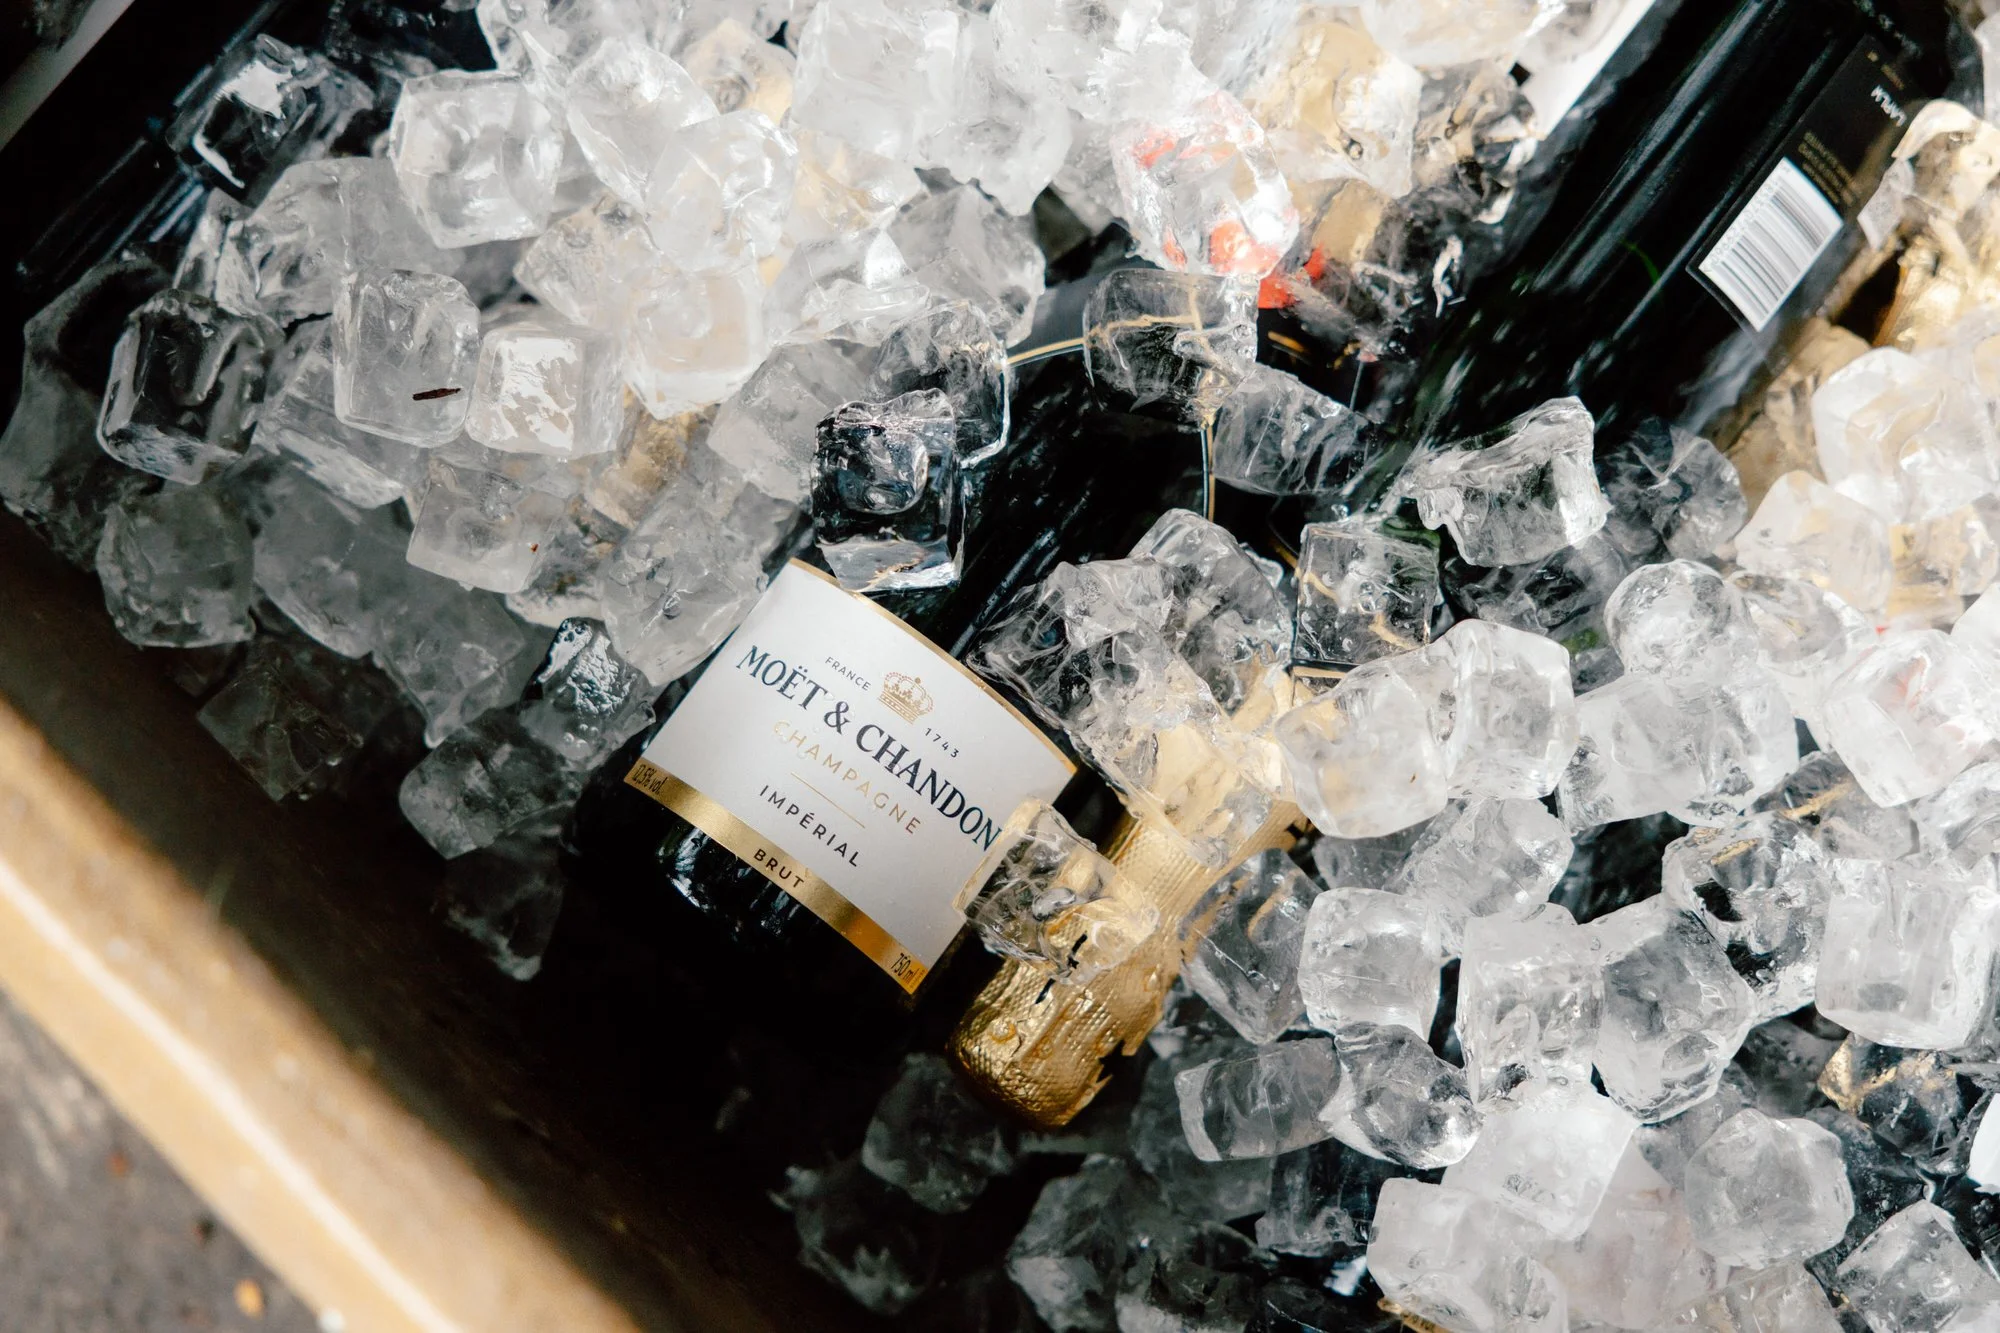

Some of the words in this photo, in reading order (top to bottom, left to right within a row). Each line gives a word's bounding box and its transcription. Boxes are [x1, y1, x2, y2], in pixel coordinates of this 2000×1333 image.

[735, 645, 828, 711] MOËT
[823, 700, 851, 735] &
[855, 723, 1003, 852] CHANDON
[824, 656, 871, 692] FRANCE
[924, 727, 960, 758] 1743
[773, 720, 921, 834] CHAMPAGNE
[753, 848, 805, 889] BRUT
[759, 784, 861, 868] IMPÉRIAL
[890, 952, 911, 976] 750
[902, 967, 920, 985] ml
